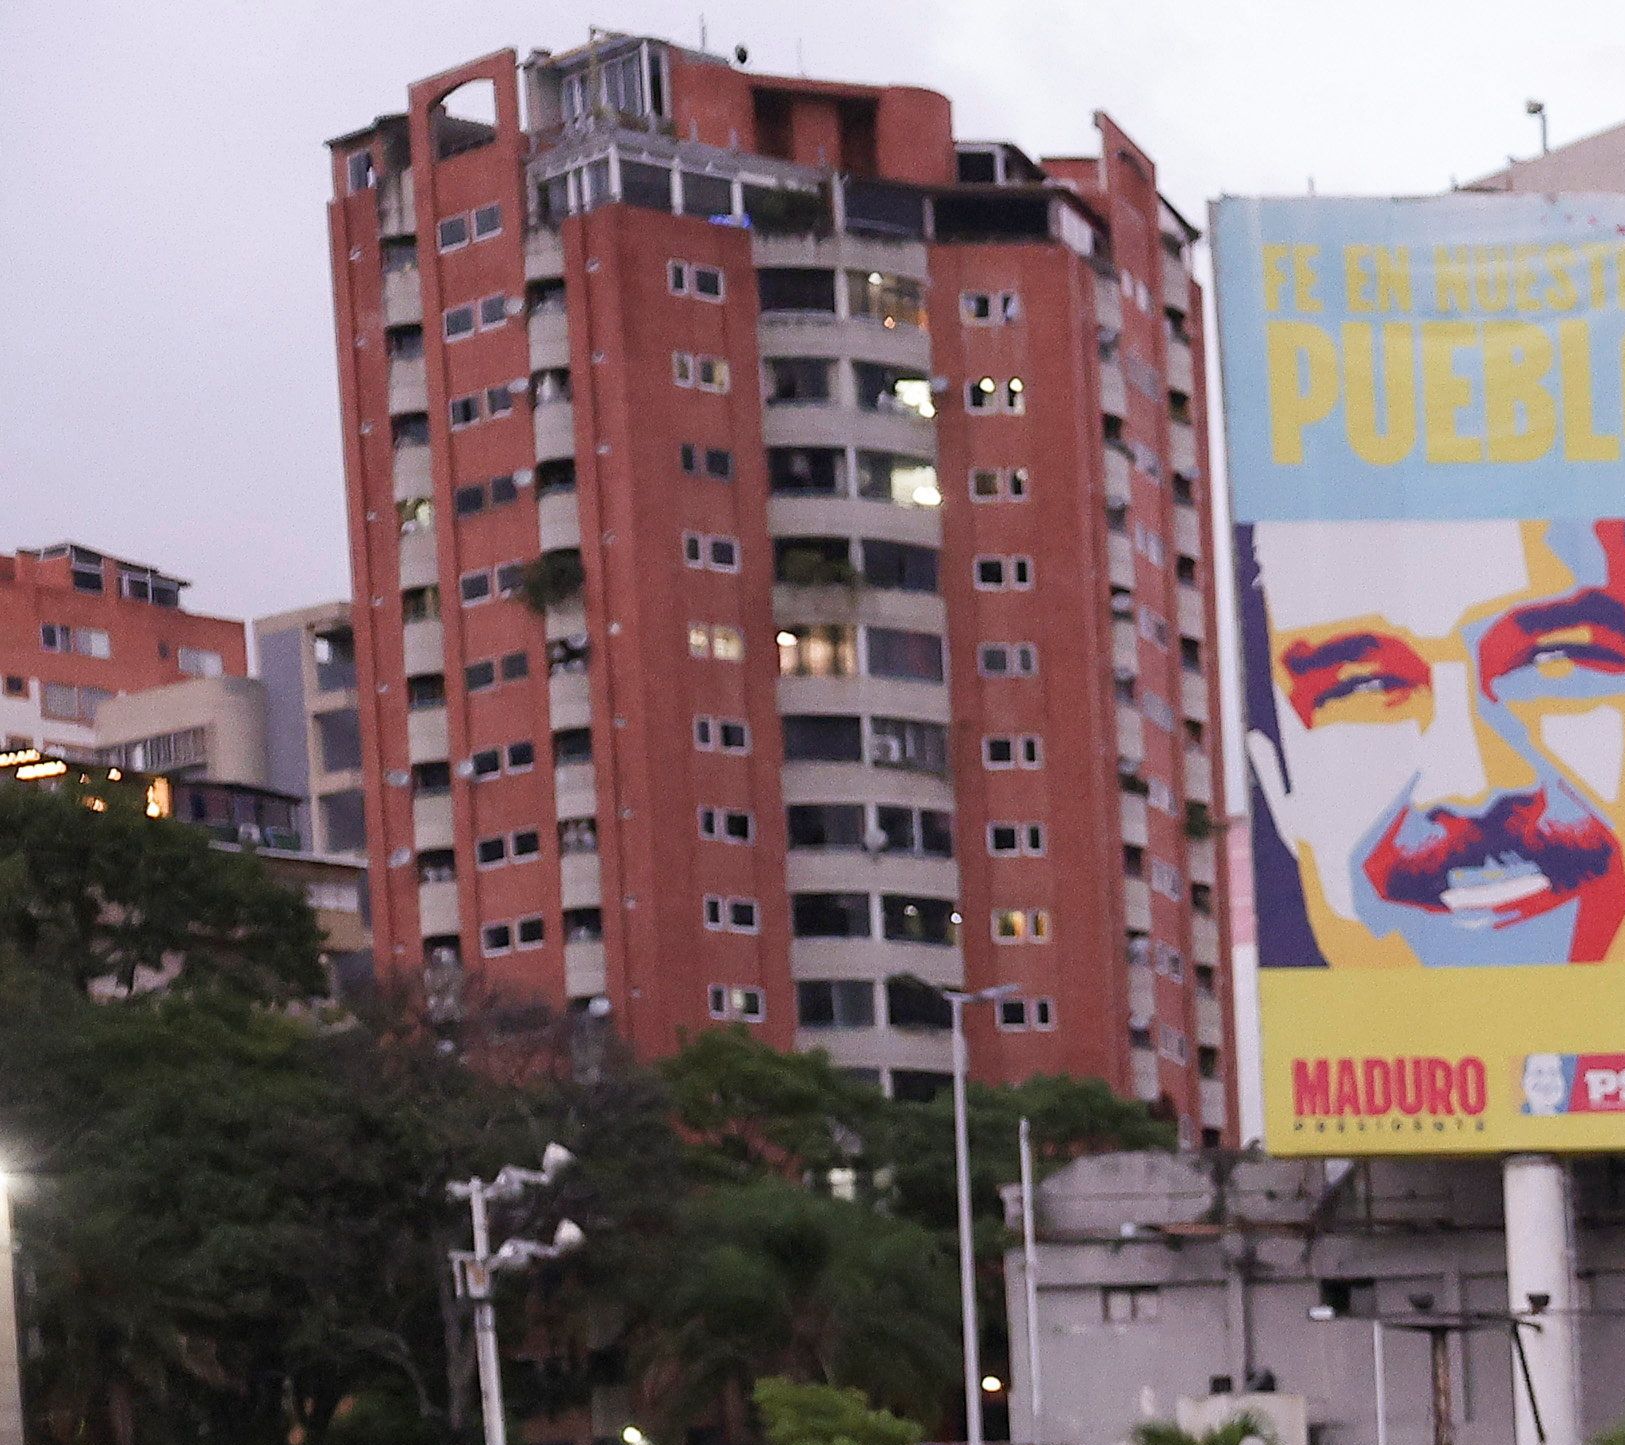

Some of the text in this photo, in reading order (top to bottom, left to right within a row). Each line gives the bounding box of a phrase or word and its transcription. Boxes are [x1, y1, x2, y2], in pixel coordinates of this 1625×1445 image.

[1261, 244, 1323, 312] FE
[1344, 244, 1414, 313] EN
[1292, 1056, 1488, 1117] MADURO
